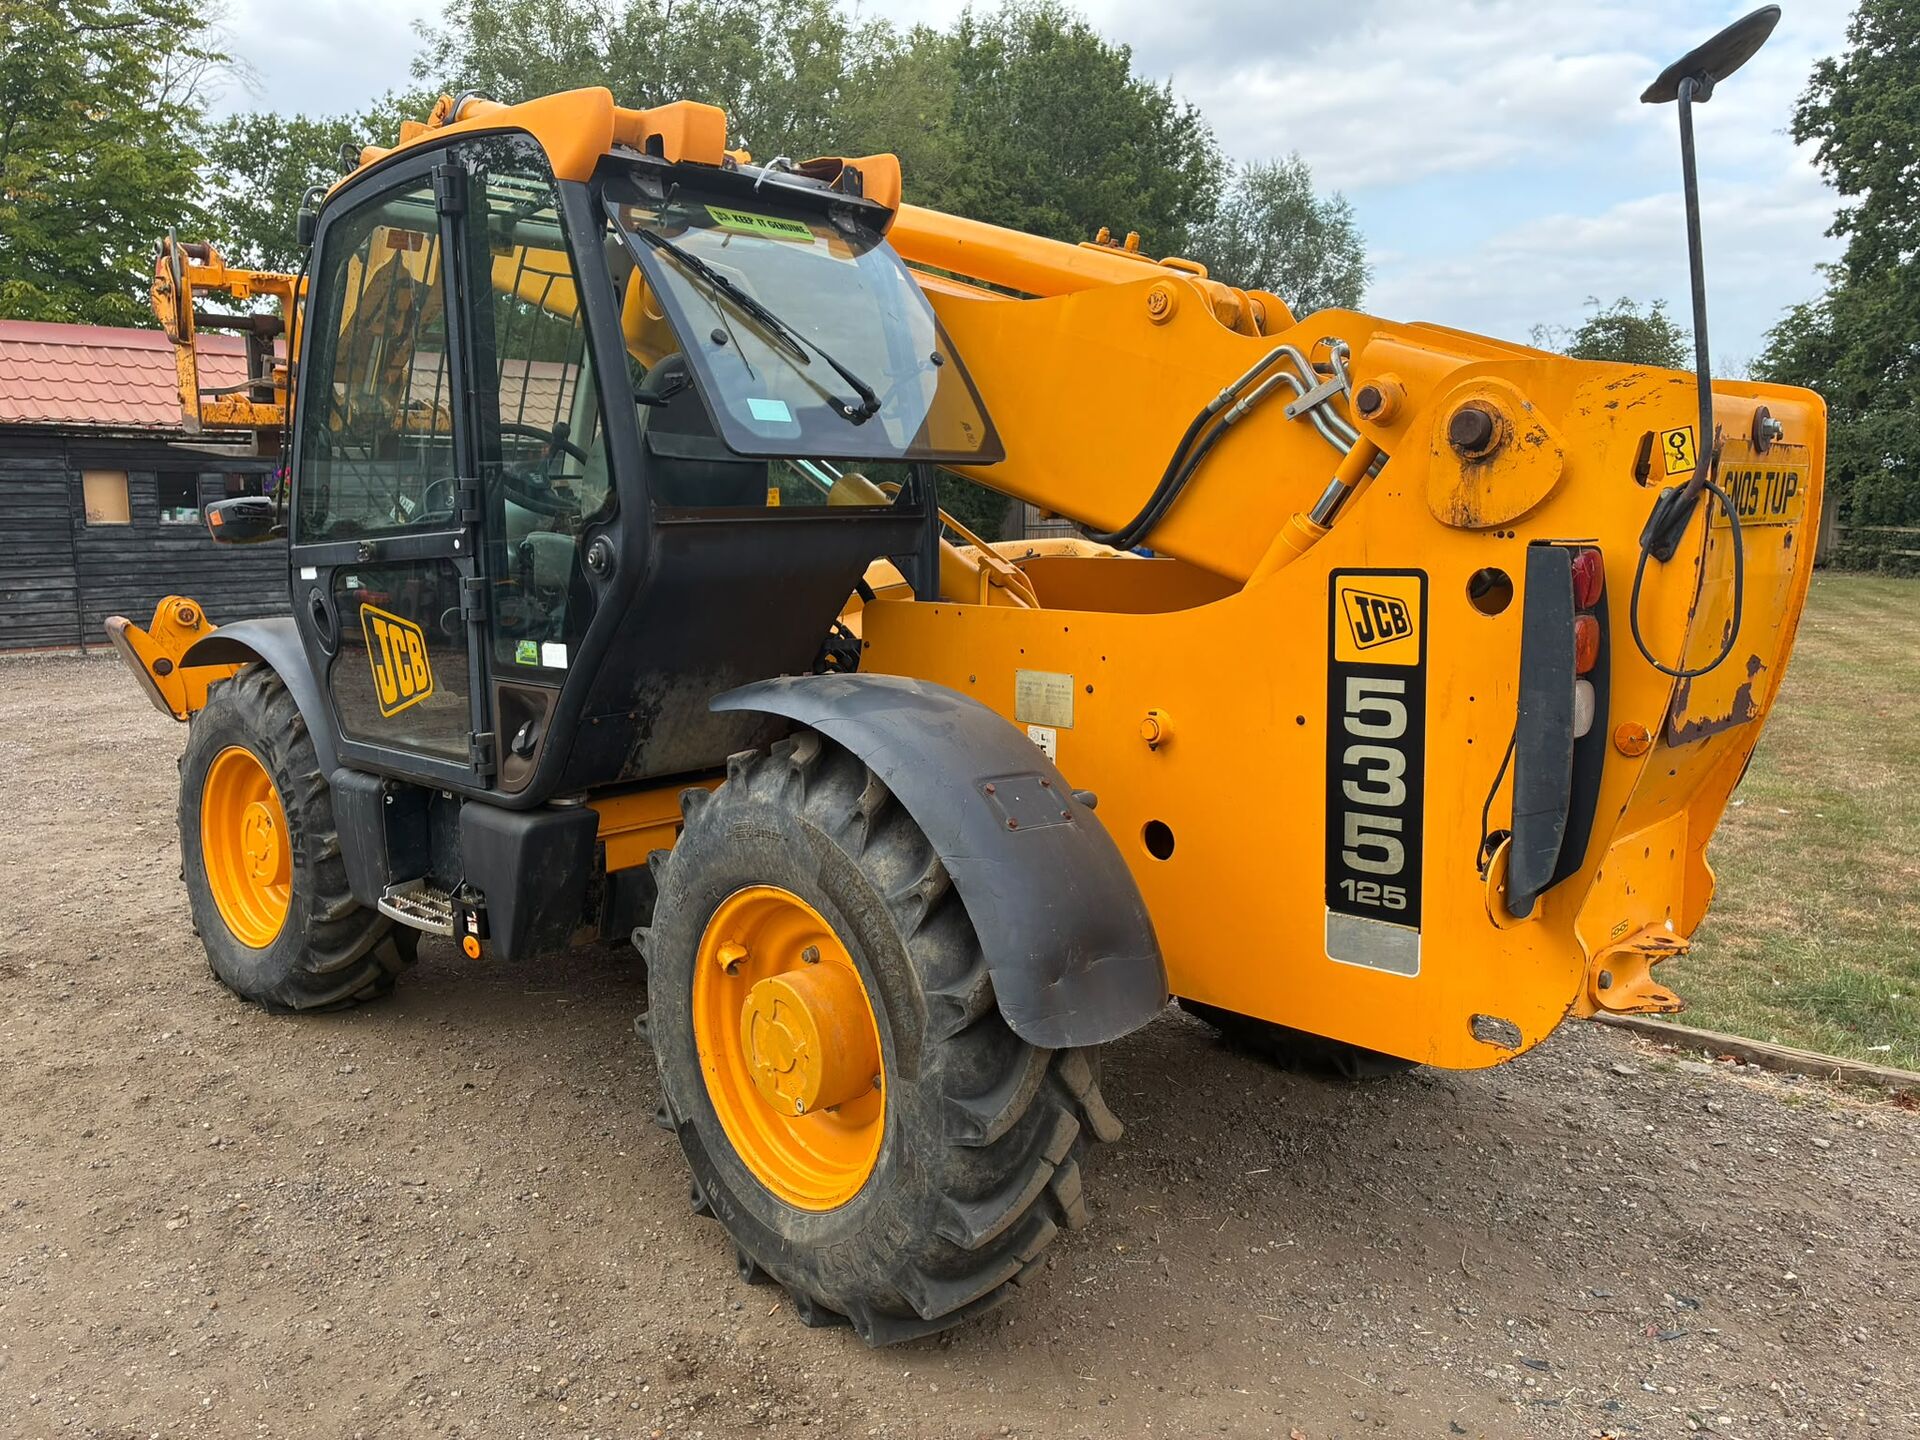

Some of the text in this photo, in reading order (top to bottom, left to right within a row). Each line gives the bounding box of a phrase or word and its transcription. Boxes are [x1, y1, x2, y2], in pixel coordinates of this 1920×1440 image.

[731, 214, 754, 225] KEEP
[756, 218, 767, 228] IT
[1763, 471, 1798, 515] TUP
[1354, 595, 1408, 643] JCB
[371, 616, 428, 705] JCB
[1339, 878, 1407, 911] 125
